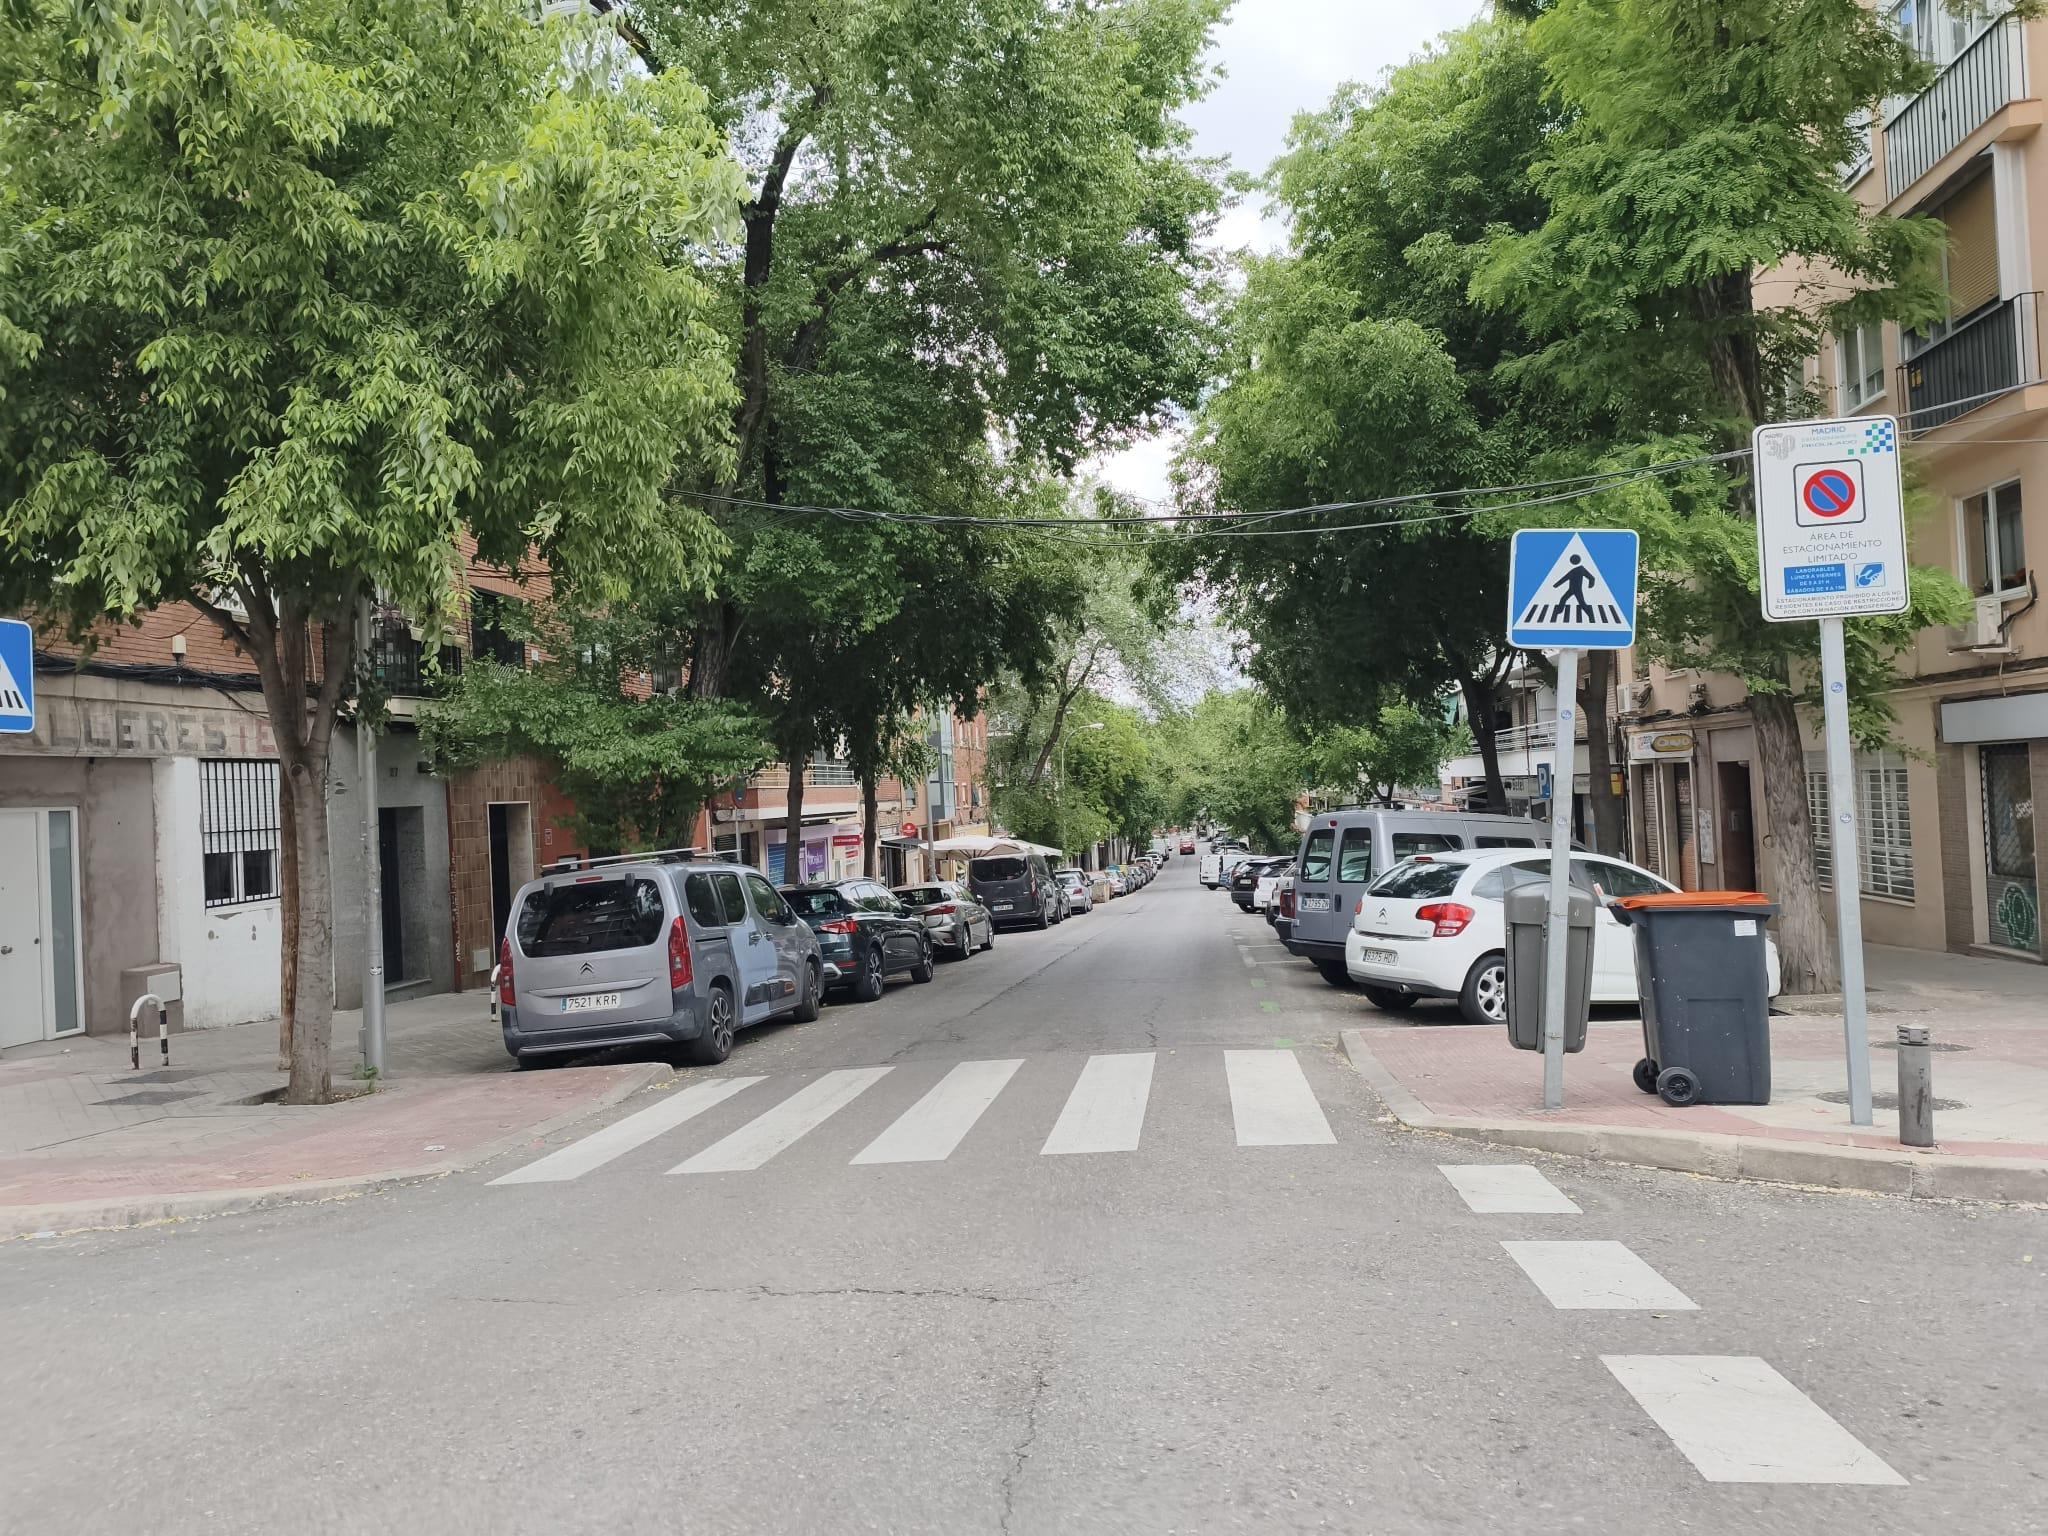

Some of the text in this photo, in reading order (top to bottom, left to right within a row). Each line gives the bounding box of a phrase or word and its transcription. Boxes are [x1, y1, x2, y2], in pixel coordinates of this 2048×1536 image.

[1811, 426, 1847, 435] MADRID
[1839, 530, 1855, 539] DE
[1782, 539, 1883, 555] ESTACIONAMIENTO
[1807, 552, 1858, 563] LIMITADO
[1795, 566, 1836, 574] LABORABLES
[1790, 573, 1810, 581] LUNES
[1816, 571, 1842, 579] VIERNES
[1775, 601, 1813, 610] RESIDENTES
[1853, 596, 1904, 604] RESTRICCIONES
[1776, 594, 1835, 604] ESTACIONAMIENTO
[1836, 593, 1869, 601] PROHIBIDO
[568, 994, 618, 1009] 7521 KRR
